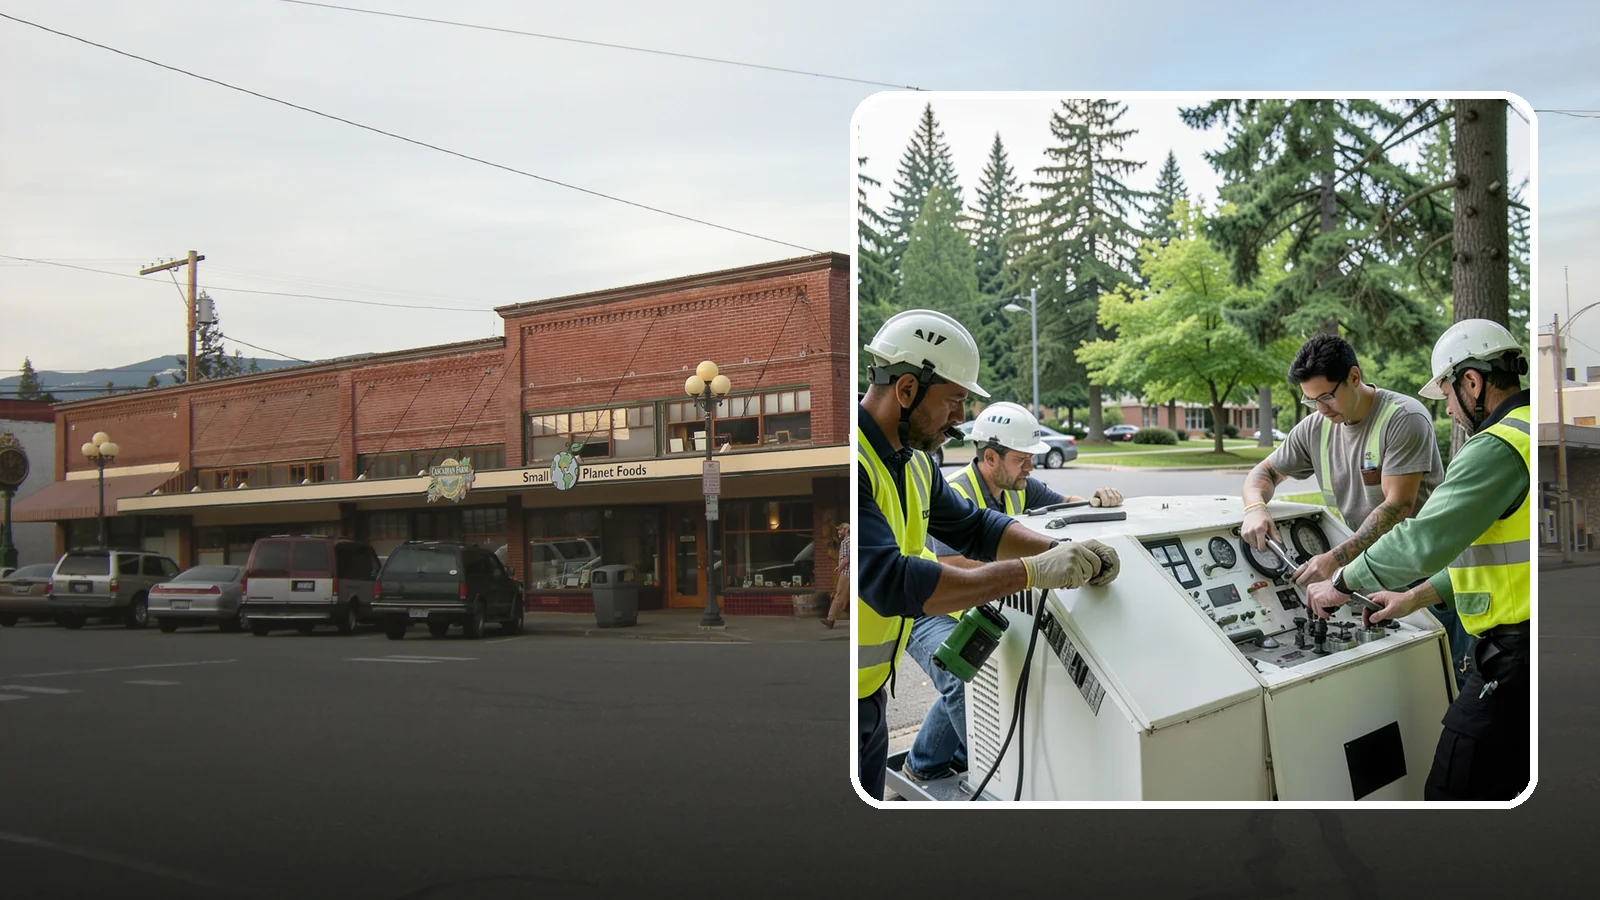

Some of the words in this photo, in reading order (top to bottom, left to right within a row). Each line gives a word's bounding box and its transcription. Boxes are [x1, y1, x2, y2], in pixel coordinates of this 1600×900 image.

[523, 471, 549, 483] Small
[583, 467, 614, 479] Planet
[617, 465, 647, 477] Foods
